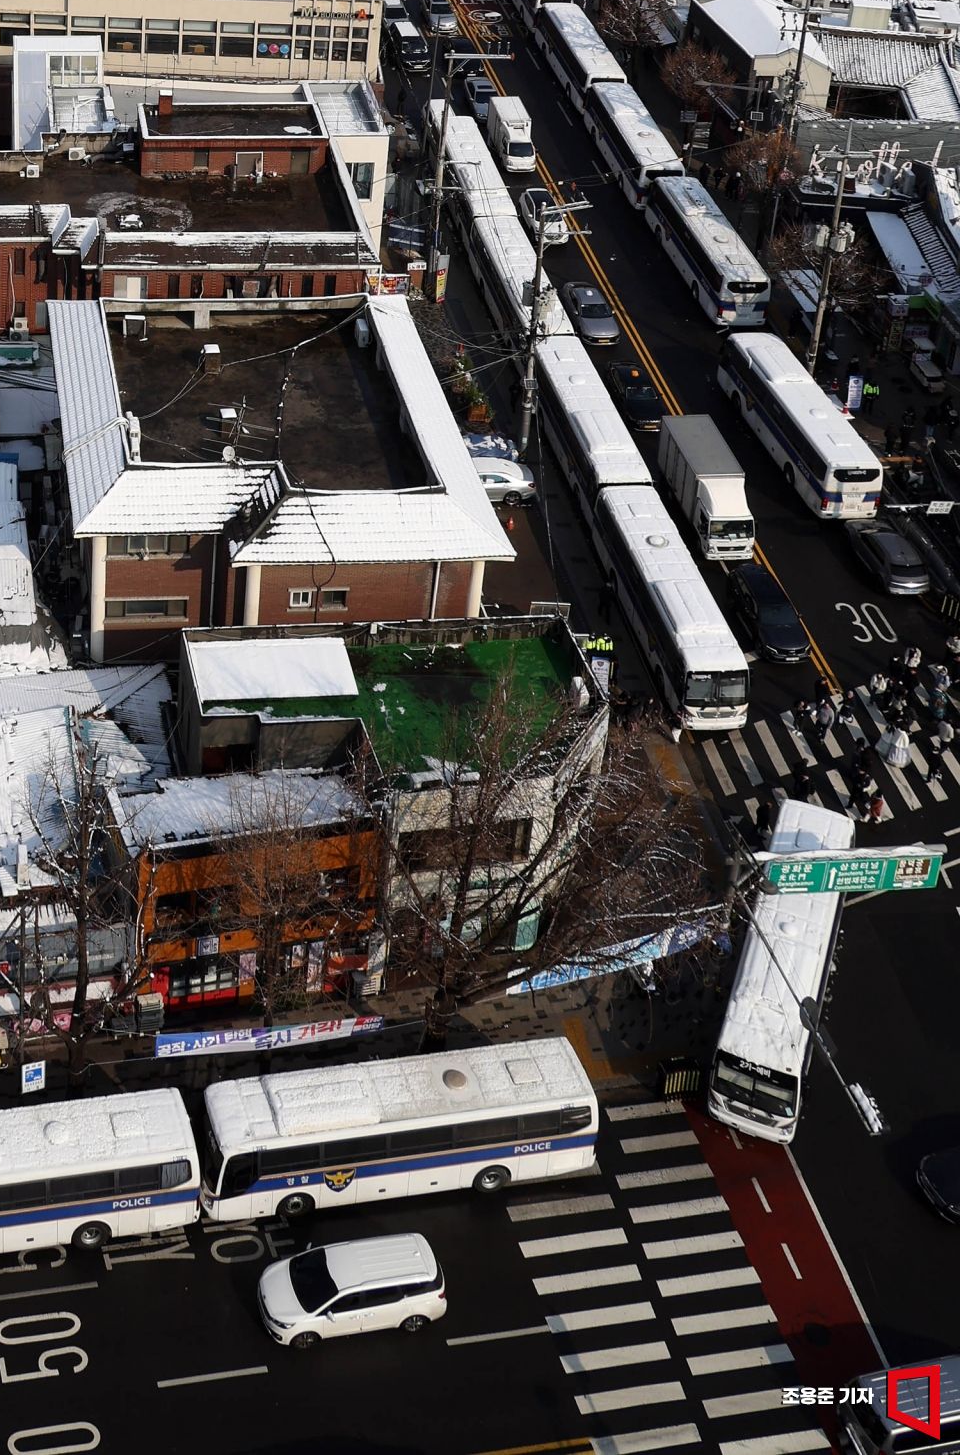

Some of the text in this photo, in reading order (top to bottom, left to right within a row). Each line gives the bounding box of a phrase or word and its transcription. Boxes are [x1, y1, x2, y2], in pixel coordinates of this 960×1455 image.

[301, 7, 320, 18] MJ
[321, 12, 356, 20] BUILDING
[835, 602, 898, 643] 30
[781, 864, 812, 874] 광화문
[840, 861, 880, 872] 삼청터널
[836, 875, 876, 885] 헌법재판소
[224, 1028, 253, 1043] 탄핵
[255, 1030, 291, 1049] 즉시
[298, 1019, 342, 1040] 기각!
[740, 1060, 771, 1078] 2기-예비
[514, 1142, 552, 1154] POLICE
[112, 1196, 152, 1209] POLICE
